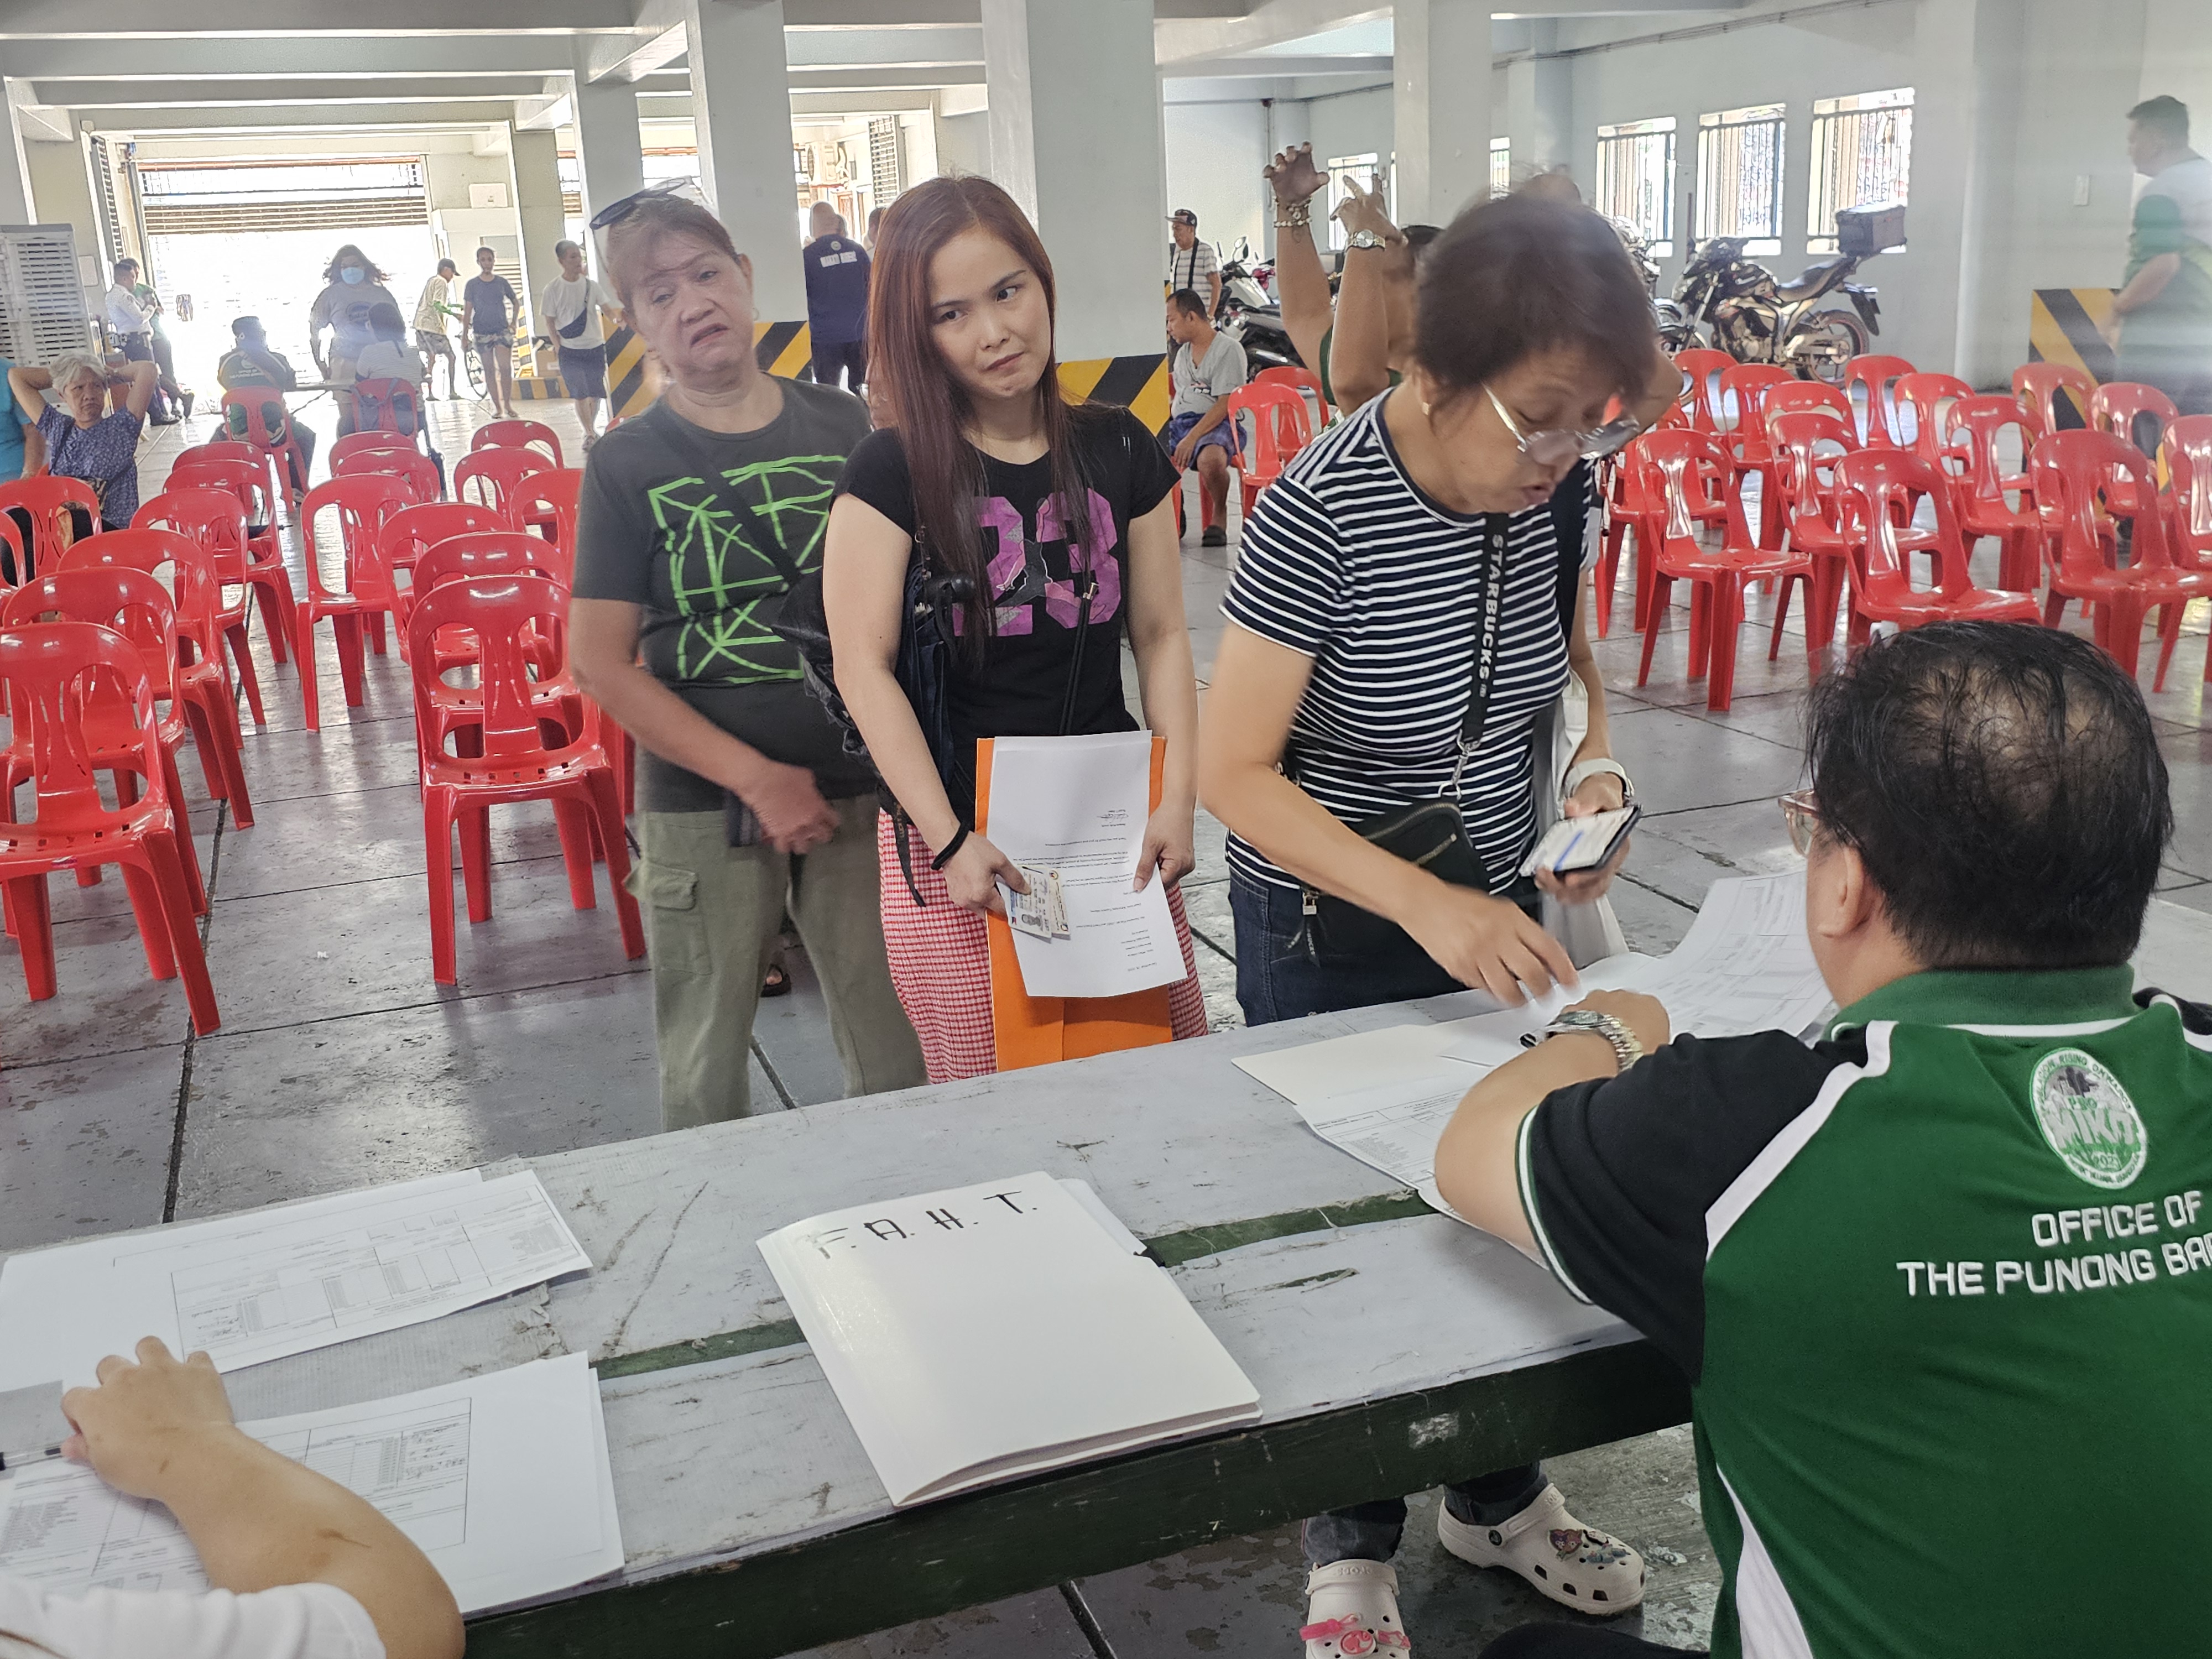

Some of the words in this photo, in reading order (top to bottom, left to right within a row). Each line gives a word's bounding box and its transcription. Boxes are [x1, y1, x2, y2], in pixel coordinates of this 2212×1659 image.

[1479, 534, 1505, 680] STARBUCKS
[2031, 1202, 2159, 1248] OFFICE
[2163, 1190, 2202, 1228] OF
[1896, 1261, 1985, 1296] THE
[1995, 1248, 2157, 1295] PUNONG
